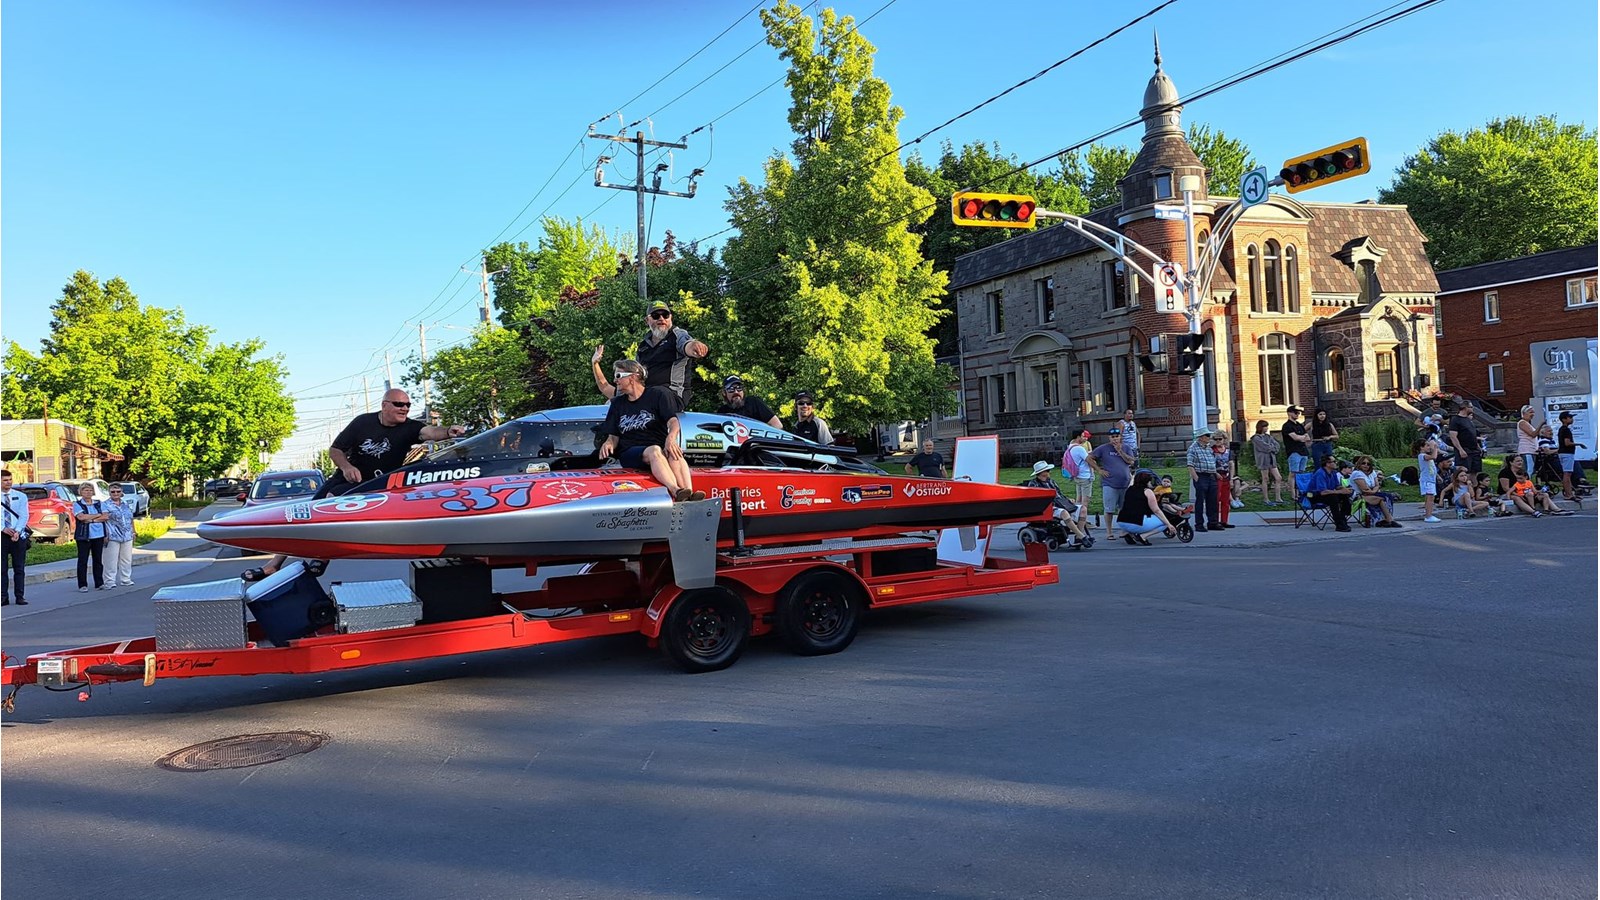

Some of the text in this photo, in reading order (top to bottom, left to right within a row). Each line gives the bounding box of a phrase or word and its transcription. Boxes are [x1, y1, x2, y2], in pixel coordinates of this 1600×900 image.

[406, 467, 481, 485] Harnois
[711, 487, 761, 498] Batries
[916, 487, 952, 497] OSTIGUY
[725, 499, 765, 513] Epert
[621, 507, 637, 518] La
[637, 507, 658, 517] Casa
[596, 517, 649, 529] du Spaghetti
